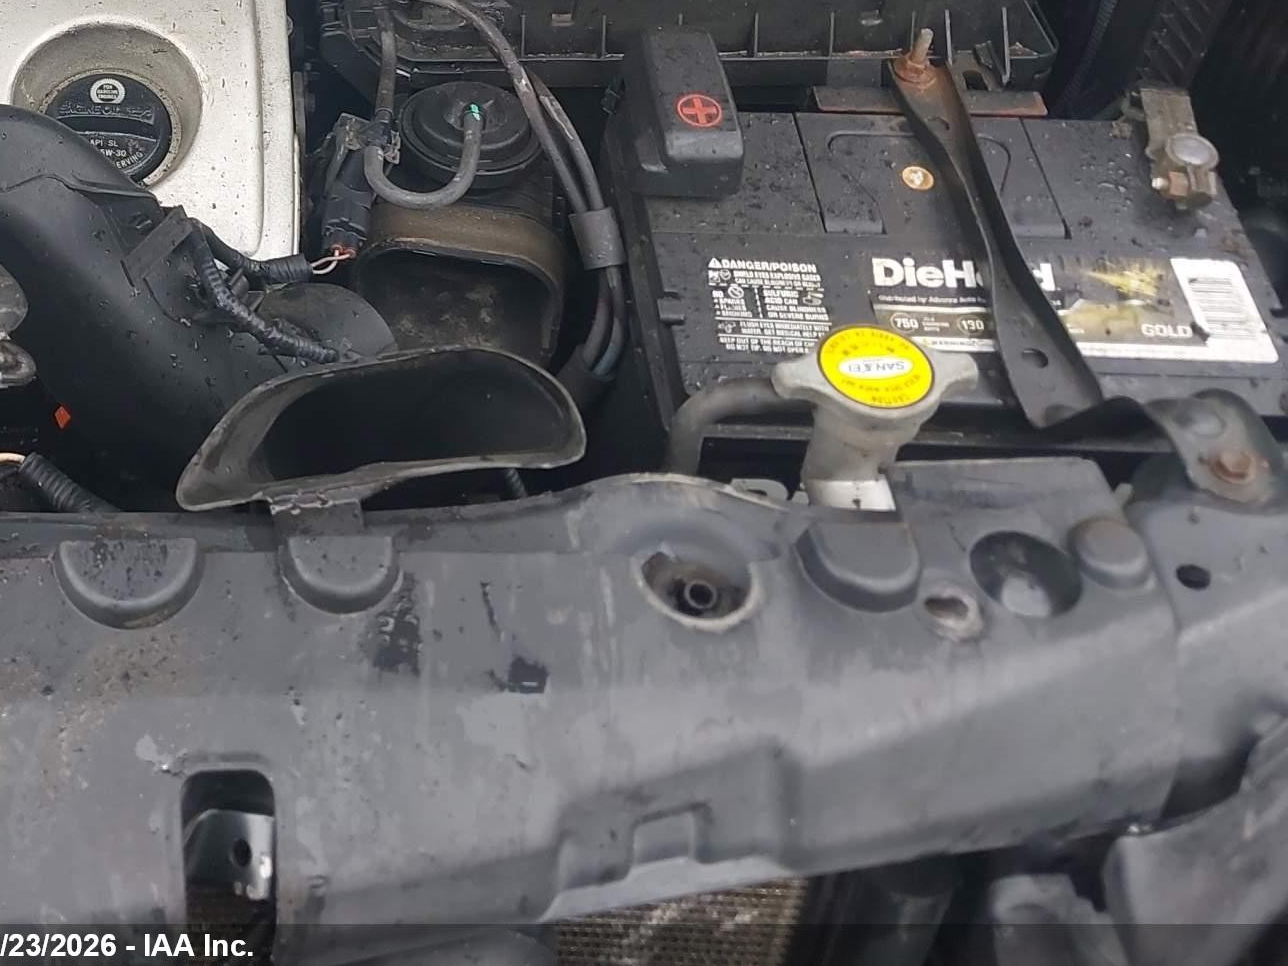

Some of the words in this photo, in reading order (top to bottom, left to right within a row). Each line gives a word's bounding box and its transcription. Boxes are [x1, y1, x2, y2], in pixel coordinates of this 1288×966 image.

[721, 259, 817, 273] DANGER/POISON
[894, 318, 919, 329] 750
[1141, 323, 1193, 338] GOLD
